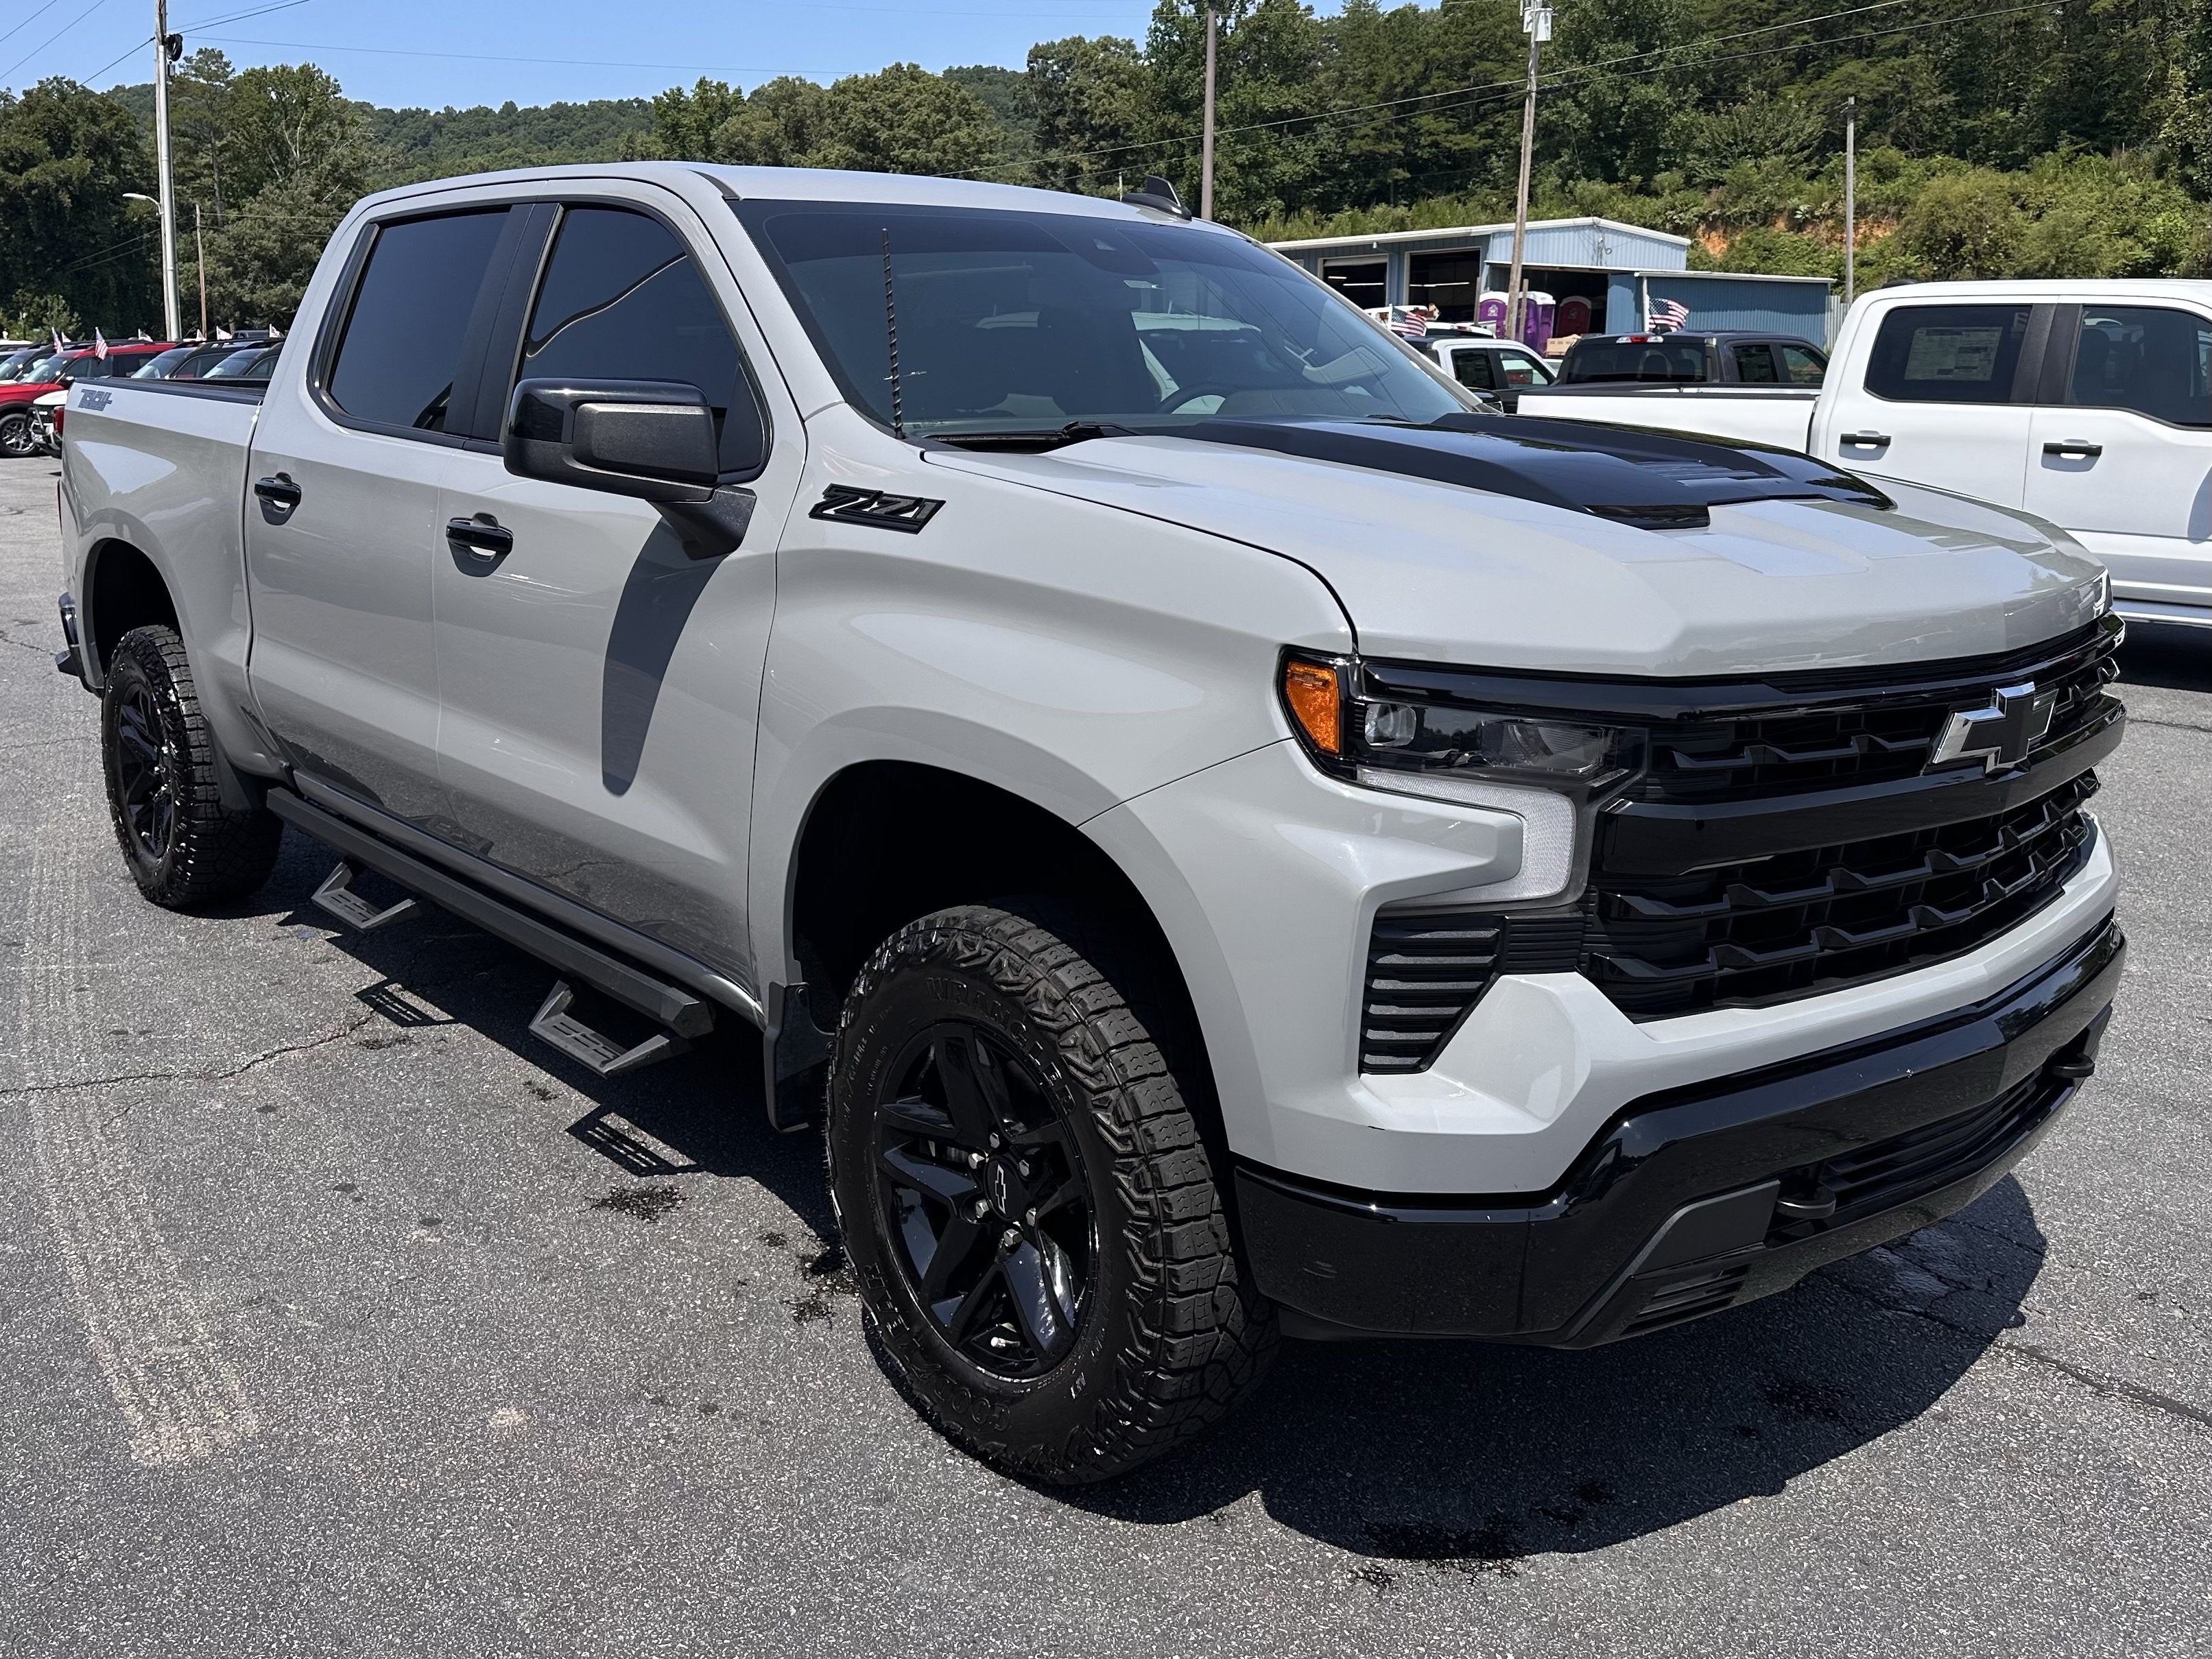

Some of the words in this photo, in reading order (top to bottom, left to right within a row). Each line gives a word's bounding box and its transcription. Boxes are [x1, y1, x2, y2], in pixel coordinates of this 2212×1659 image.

[81, 389, 112, 404] TRAIL
[808, 483, 947, 535] Z71
[925, 977, 1076, 1116] WRANGLER
[864, 1263, 1012, 1431] GOODYEAR
